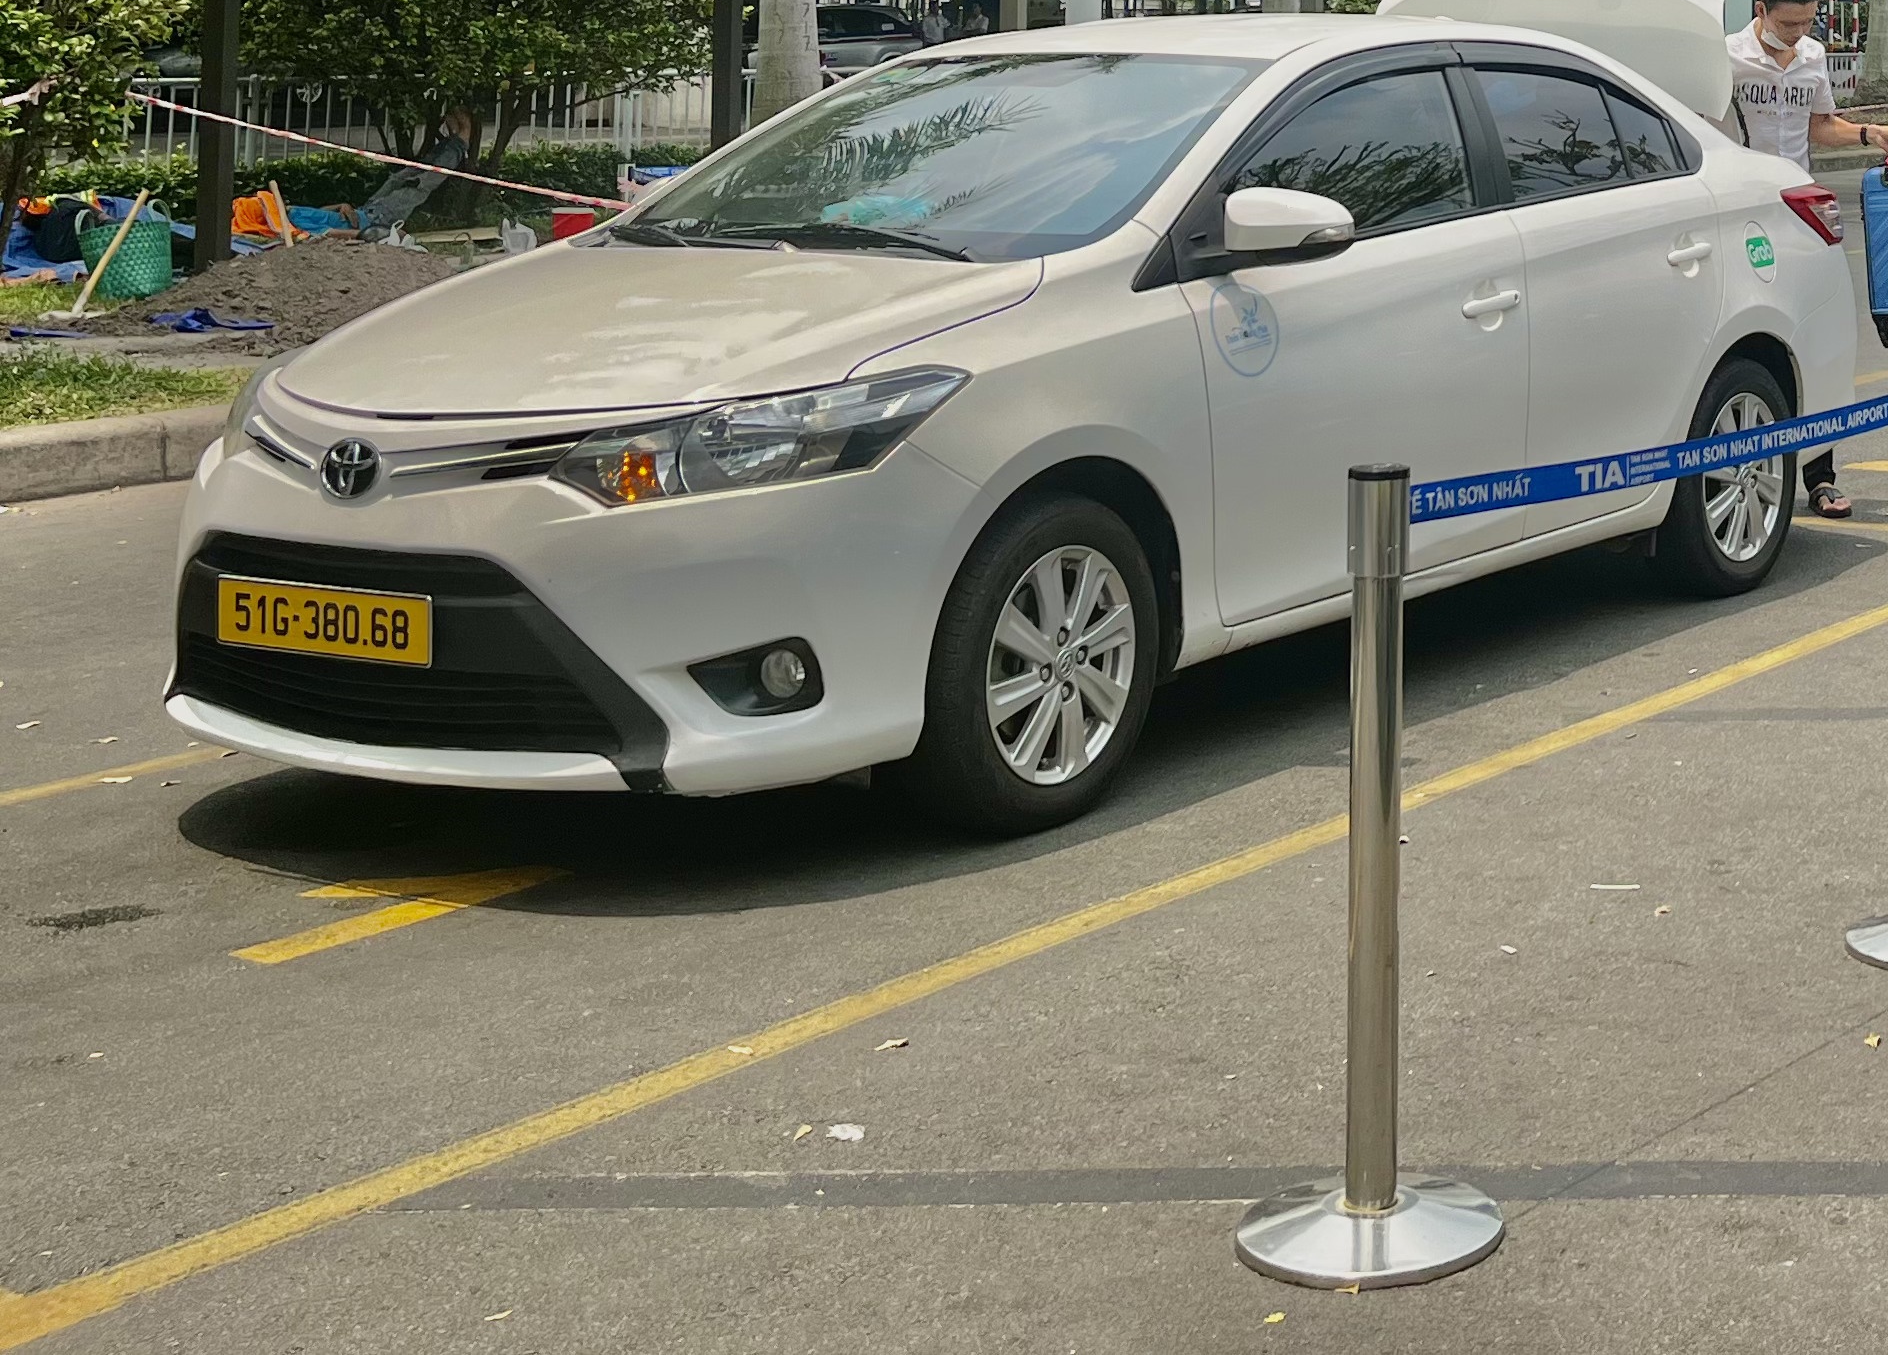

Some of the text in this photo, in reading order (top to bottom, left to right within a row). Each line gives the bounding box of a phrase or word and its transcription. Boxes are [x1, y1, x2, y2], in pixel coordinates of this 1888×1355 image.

[1747, 239, 1773, 264] Grab
[1410, 487, 1423, 515] Ế
[1426, 486, 1455, 512] TÂN
[1457, 484, 1490, 505] SƠN
[1492, 472, 1532, 502] NHẤT
[1575, 460, 1626, 493] TIA
[1677, 448, 1701, 470] TAN
[1702, 444, 1728, 465] SON
[1729, 434, 1760, 458] NHAT
[1761, 418, 1846, 450] INTERNATIONAL
[234, 591, 410, 651] 51G-380.68
